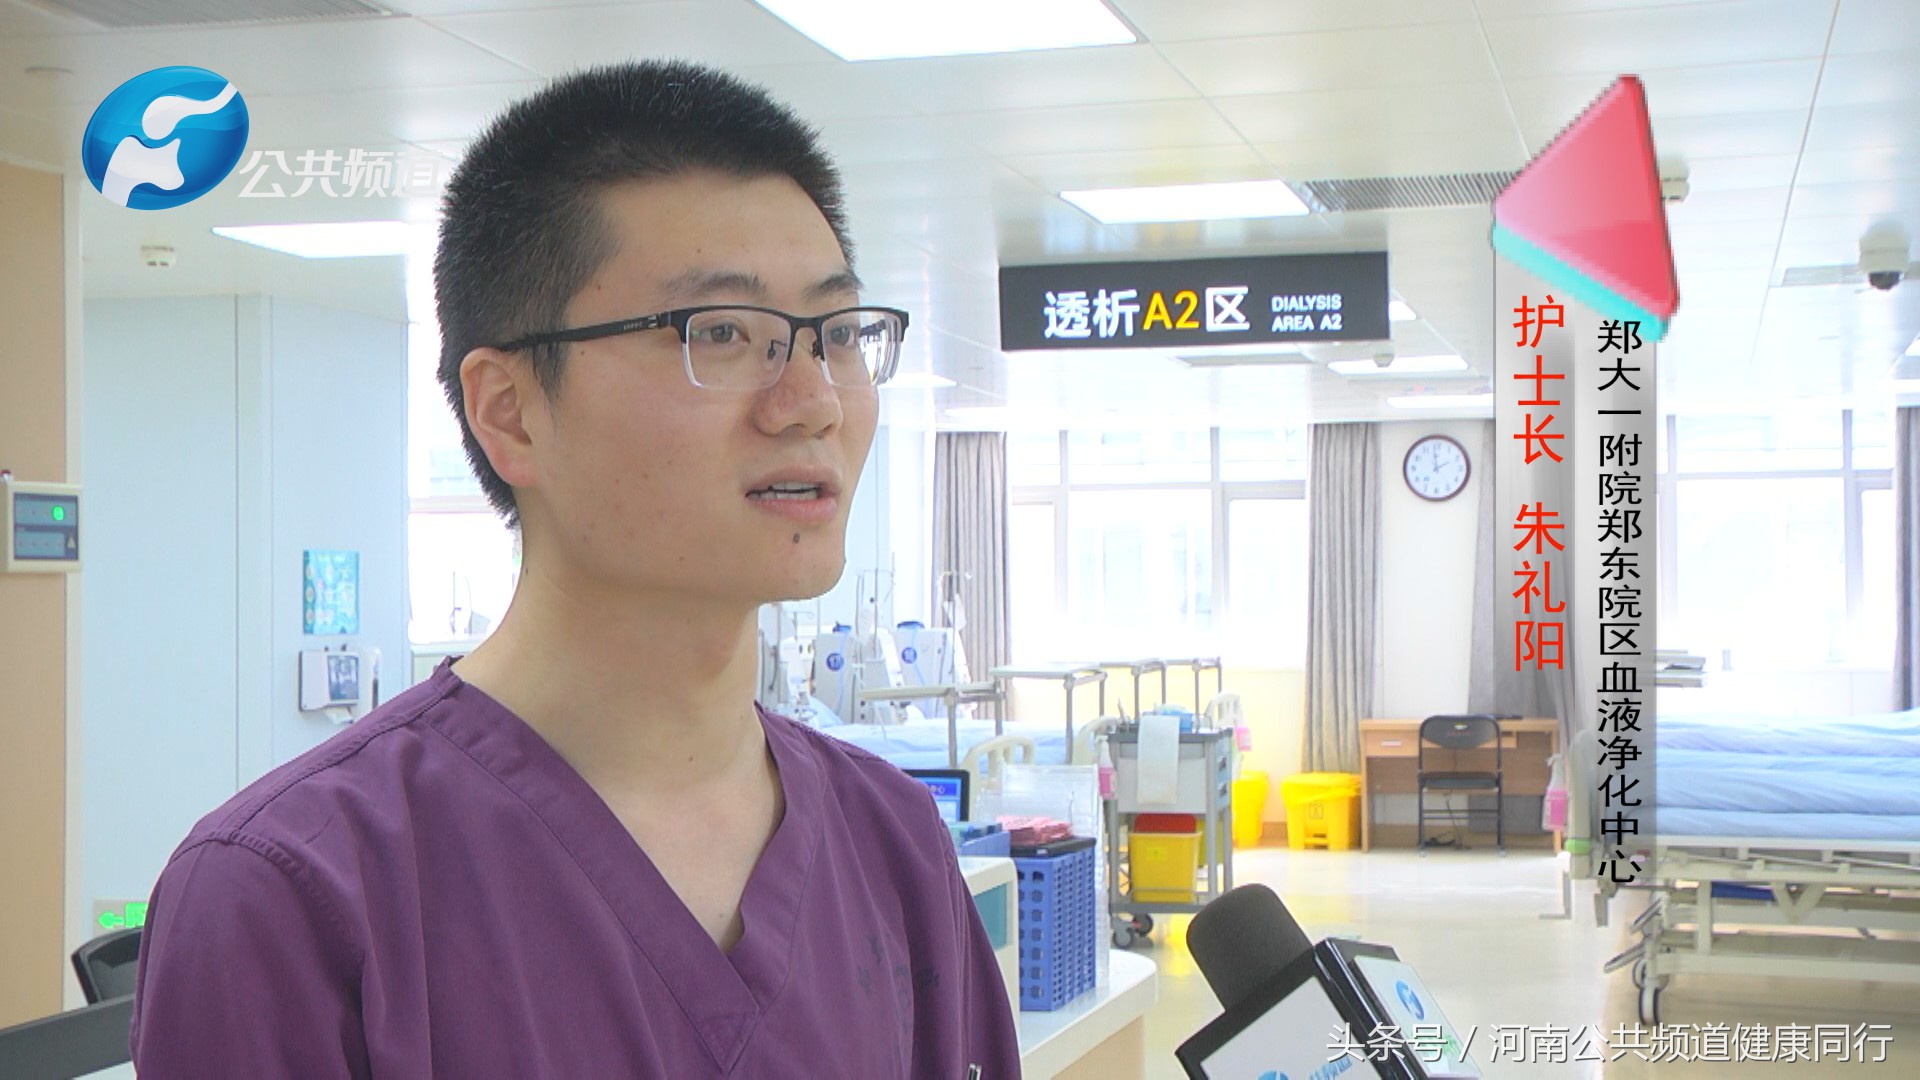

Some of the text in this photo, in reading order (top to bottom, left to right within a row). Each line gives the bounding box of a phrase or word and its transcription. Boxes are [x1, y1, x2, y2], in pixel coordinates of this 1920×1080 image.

[1043, 285, 1251, 339] 透析A2区
[1271, 293, 1342, 312] DIALYSIS
[1271, 313, 1342, 332] AREA A2
